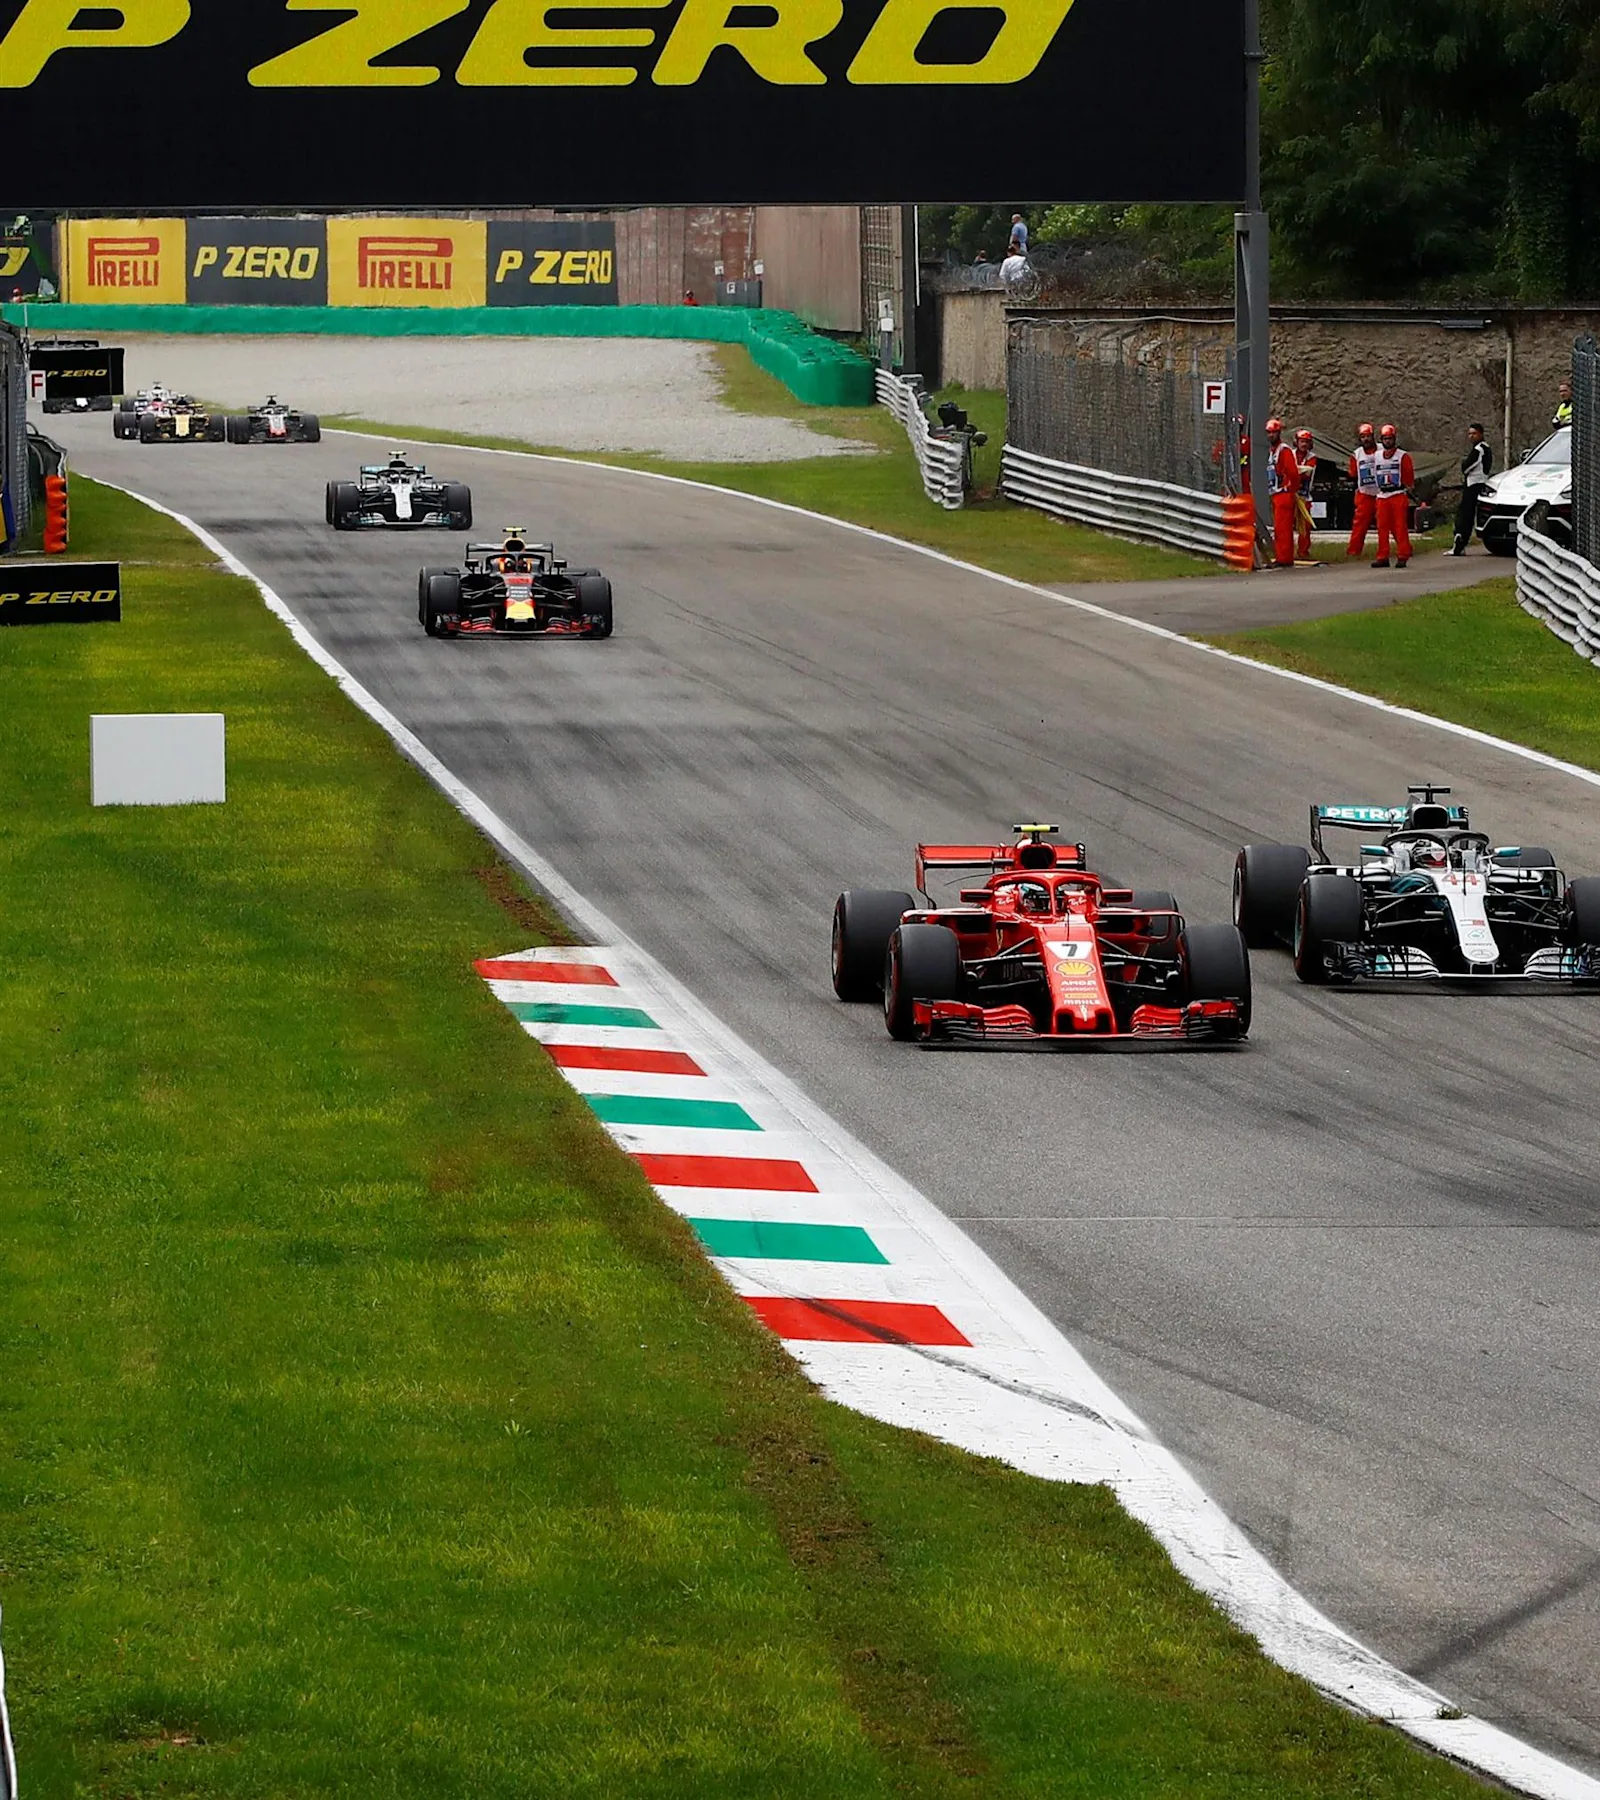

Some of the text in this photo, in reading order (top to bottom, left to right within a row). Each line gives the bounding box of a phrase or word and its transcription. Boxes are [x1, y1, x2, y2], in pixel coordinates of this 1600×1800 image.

[0, 0, 1071, 88] P ZERO
[88, 237, 160, 286] PIRELLI
[193, 246, 320, 280] P ZERO
[358, 237, 454, 290] PIRELLI
[495, 250, 613, 285] P ZERO
[31, 373, 43, 398] F
[47, 369, 108, 378] P ZERO
[1206, 385, 1222, 410] F
[0, 590, 117, 606] P ZERO
[1441, 872, 1481, 886] 44
[1061, 943, 1078, 957] 7
